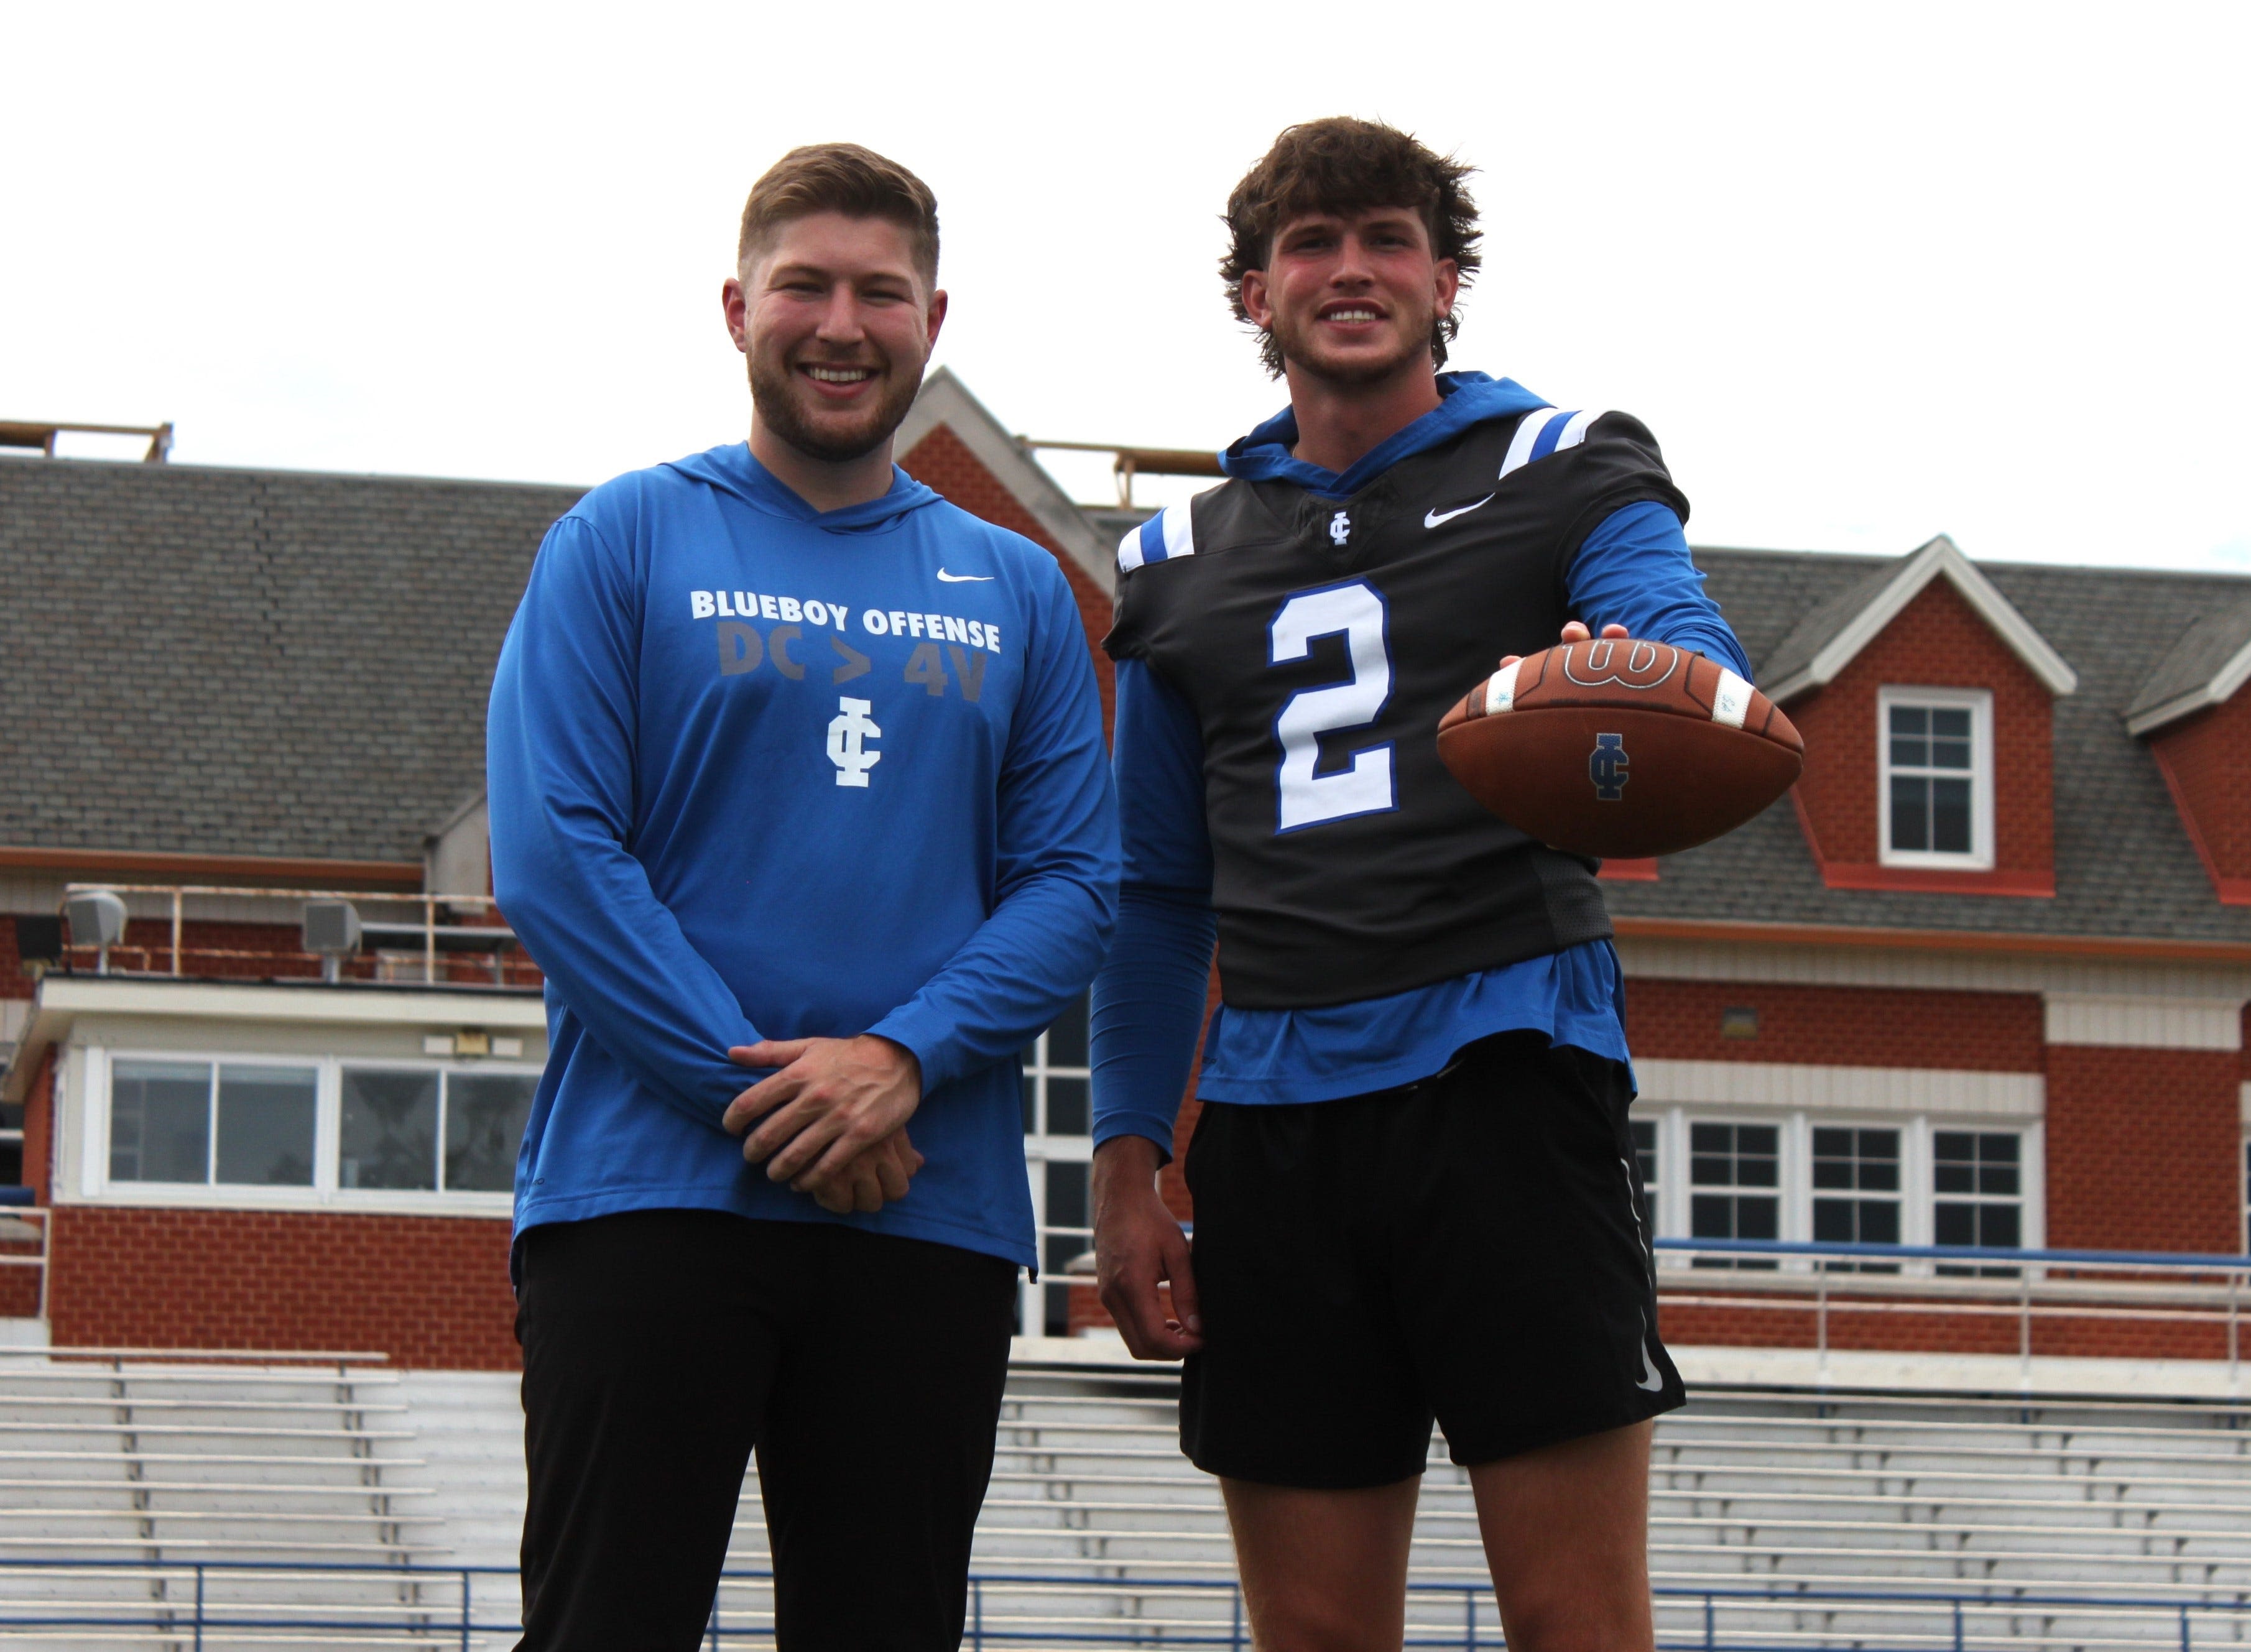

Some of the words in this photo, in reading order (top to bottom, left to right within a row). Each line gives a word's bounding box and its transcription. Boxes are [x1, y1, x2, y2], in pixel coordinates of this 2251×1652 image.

[690, 590, 848, 632] BLUEBOY
[862, 609, 1001, 655] OFFENSE
[716, 621, 806, 681] DC
[903, 642, 987, 704] 4V
[1266, 575, 1400, 836] 2
